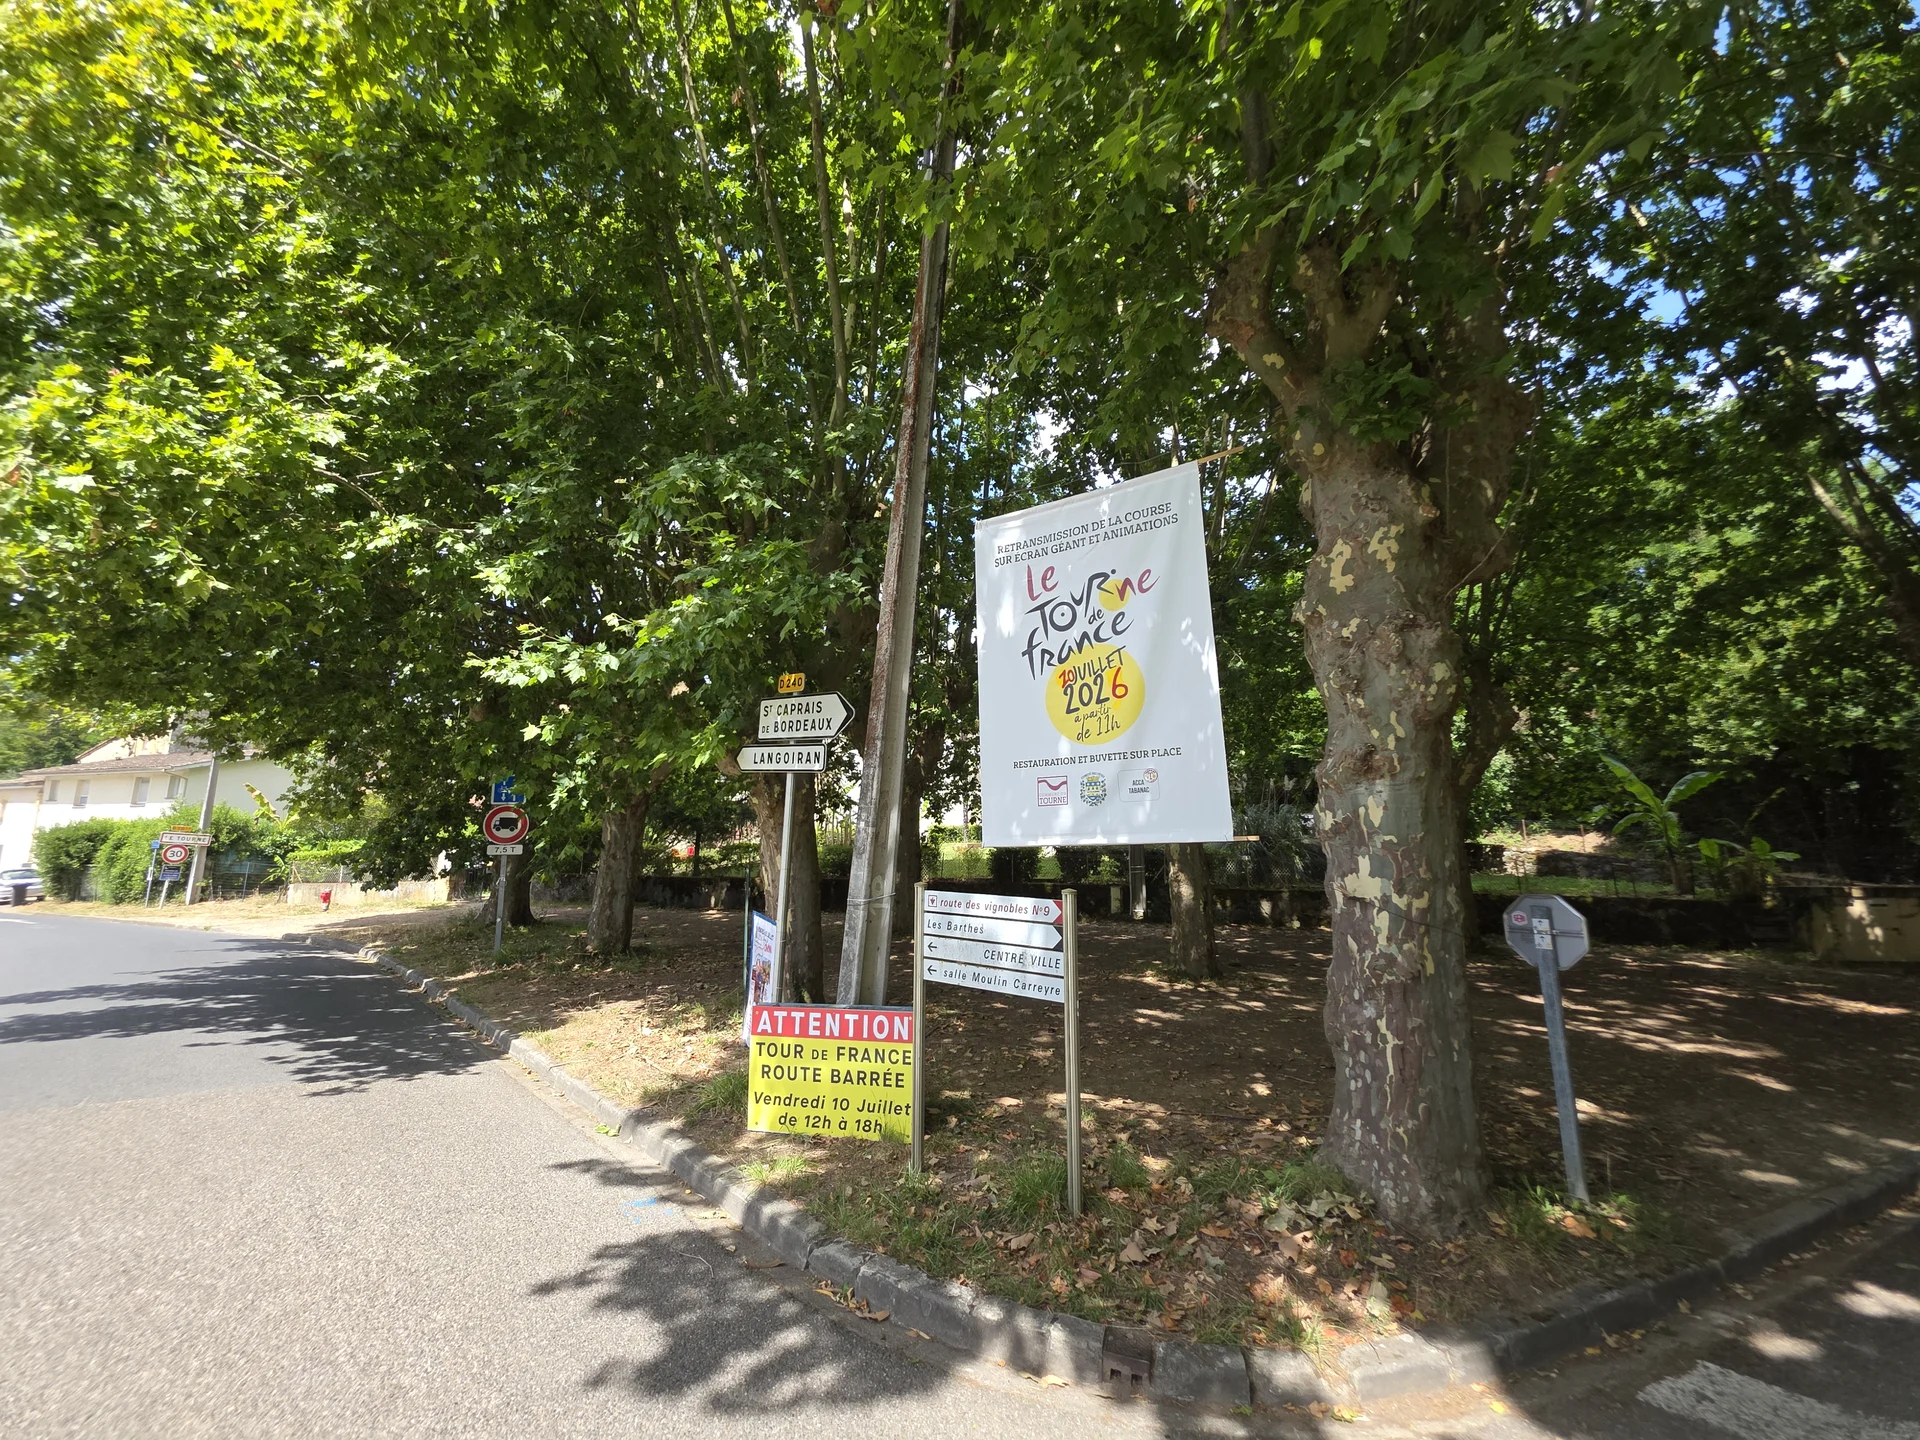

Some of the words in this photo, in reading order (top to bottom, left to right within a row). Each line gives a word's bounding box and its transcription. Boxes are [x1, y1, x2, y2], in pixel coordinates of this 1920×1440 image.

[997, 524, 1088, 554] RETRANSMISSION
[1092, 520, 1106, 531] DE
[1108, 516, 1122, 526] LA
[1125, 502, 1172, 522] COURSE
[995, 555, 1012, 568] SUR
[1015, 552, 1048, 563] ÉCRAN
[1051, 538, 1086, 554] GÉANT
[1089, 534, 1100, 545] ET
[1103, 513, 1178, 541] ANIMATIONS
[1026, 564, 1059, 600] Le
[1088, 606, 1104, 625] de
[1058, 669, 1075, 688] 10
[1073, 646, 1126, 685] JUILLET
[1063, 667, 1128, 714] 2026
[776, 701, 823, 717] CAPRAIS
[1082, 704, 1112, 724] partir
[774, 718, 832, 733] BORDEAUX
[1077, 722, 1091, 742] de
[1097, 714, 1121, 736] 11h
[753, 752, 821, 764] LANGOIRAN
[1013, 756, 1076, 769] RESTAURATION
[1078, 756, 1088, 764] ET
[1090, 752, 1128, 763] BUVETTE
[1130, 750, 1149, 760] SUR
[1151, 747, 1182, 757] PLACE
[1040, 796, 1066, 804] TOURNE
[940, 899, 962, 908] route
[966, 900, 980, 910] des
[984, 901, 1028, 914] vignobles
[927, 919, 942, 930] Les
[947, 921, 984, 934] Barthes
[984, 950, 1024, 964] CENTRE
[1031, 954, 1061, 969] VILLE
[943, 969, 967, 981] salle
[972, 972, 1008, 987] Moulin
[1014, 978, 1061, 996] Carreyre
[756, 1010, 909, 1040] ATTENTION
[756, 1042, 804, 1059] TOUR
[811, 1050, 828, 1060] DE
[837, 1046, 912, 1066] FRANCE
[761, 1064, 821, 1083] ROUTE
[830, 1068, 905, 1088] BARRÉE
[754, 1091, 826, 1109] Vendredi
[832, 1098, 850, 1111] 10
[857, 1099, 912, 1116] Juillet
[778, 1112, 798, 1126] de
[804, 1115, 831, 1129] 12h
[838, 1117, 848, 1130] à
[855, 1119, 883, 1133] 18h
